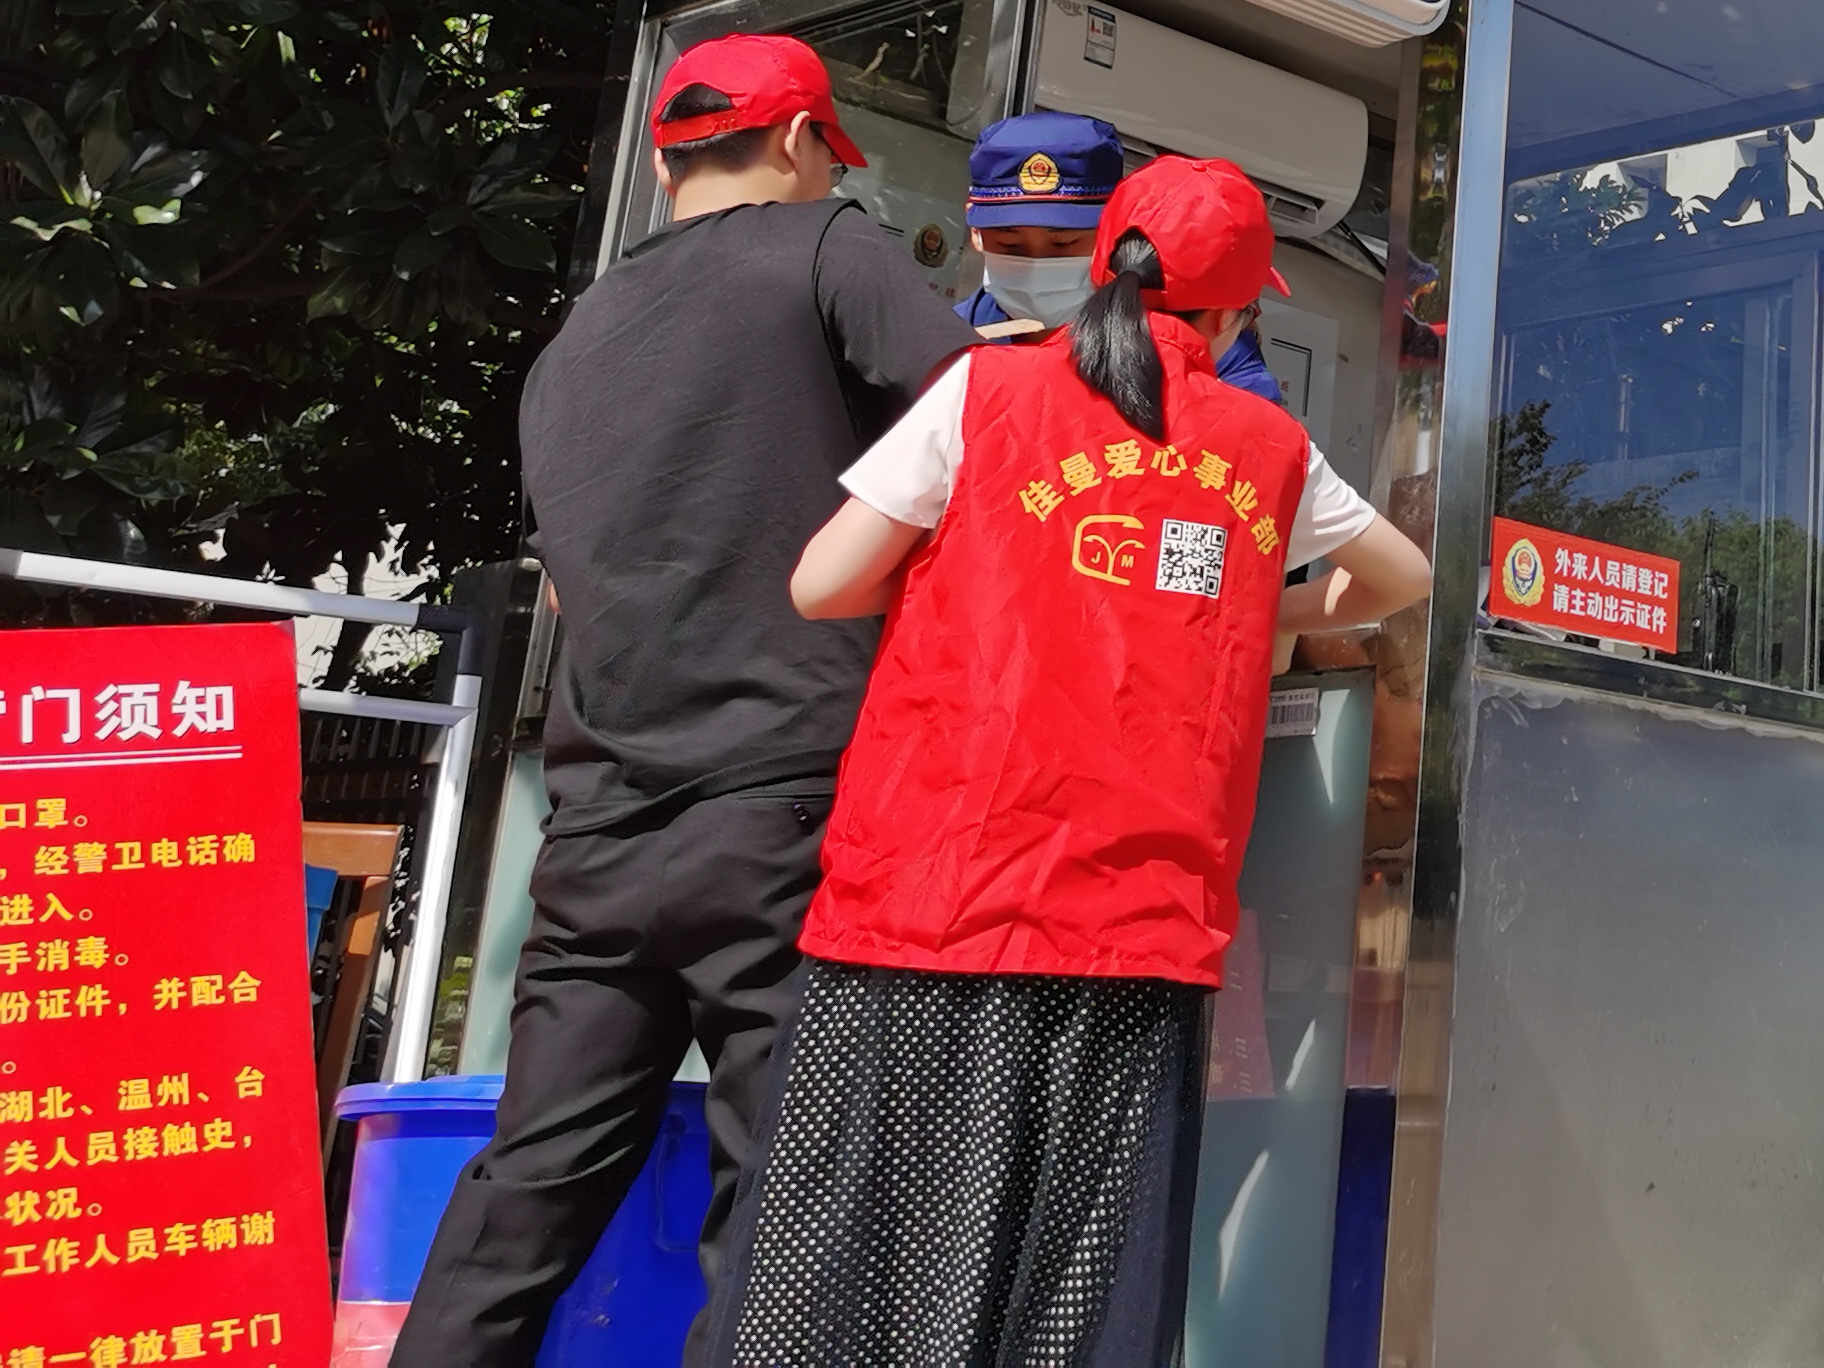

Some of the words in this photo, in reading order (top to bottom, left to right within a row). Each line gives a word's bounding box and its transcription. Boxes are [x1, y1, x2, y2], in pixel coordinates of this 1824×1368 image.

[1018, 438, 1281, 556] 佳曼爱心事业部
[1553, 547, 1669, 599] 外来人员请登记
[1552, 583, 1668, 635] 请主动出示证件
[0, 679, 236, 744] 门须知
[2, 1211, 276, 1277] 工作人员车辆谢
[0, 1312, 283, 1368] 请一律放置于门
